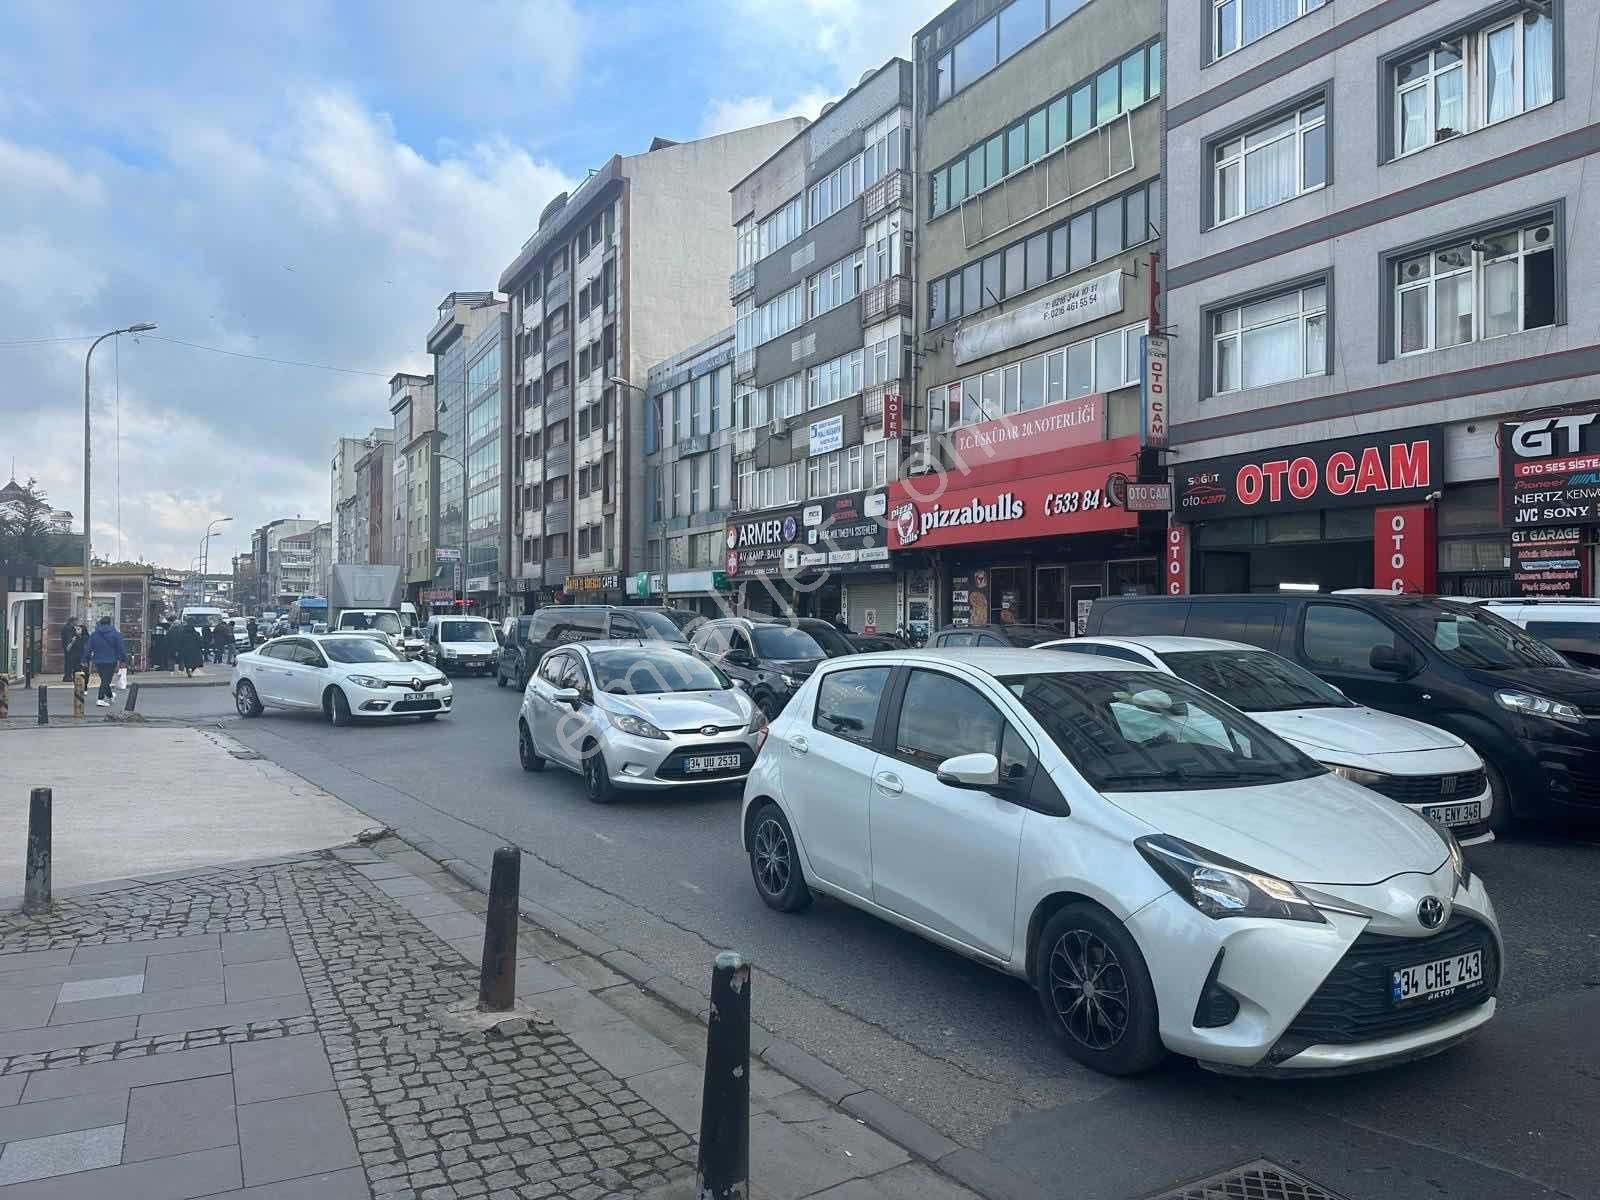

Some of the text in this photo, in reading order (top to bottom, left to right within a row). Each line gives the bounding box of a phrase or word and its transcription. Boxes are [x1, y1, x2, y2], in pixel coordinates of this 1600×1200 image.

[1050, 305, 1065, 318] 0216
[1080, 297, 1088, 308] 55
[1089, 293, 1097, 304] 54
[1151, 361, 1163, 394] OTO
[888, 393, 898, 440] NOTER
[1151, 402, 1164, 434] CAM
[1511, 412, 1598, 458] GT
[1236, 440, 1431, 505] OTO CAM
[1521, 465, 1543, 474] OTO
[1545, 462, 1566, 472] SES
[1055, 491, 1079, 515] 533
[1083, 488, 1101, 512] 84
[1129, 487, 1169, 500] OTO CAM
[1514, 490, 1563, 505] HERTZ
[891, 503, 913, 520] pizza
[920, 492, 1024, 536] pizzabulls
[1515, 506, 1590, 522] JVC SONY
[739, 520, 782, 547] ARMER
[1511, 528, 1580, 542] GT GARAGE
[1170, 531, 1180, 594] OTO C
[1391, 515, 1405, 593] OTO C
[690, 758, 701, 769] 34
[717, 755, 739, 767] 2533
[1431, 809, 1442, 822] 34
[1445, 807, 1461, 822] ENY
[1402, 952, 1480, 996] 34 CHE 243
